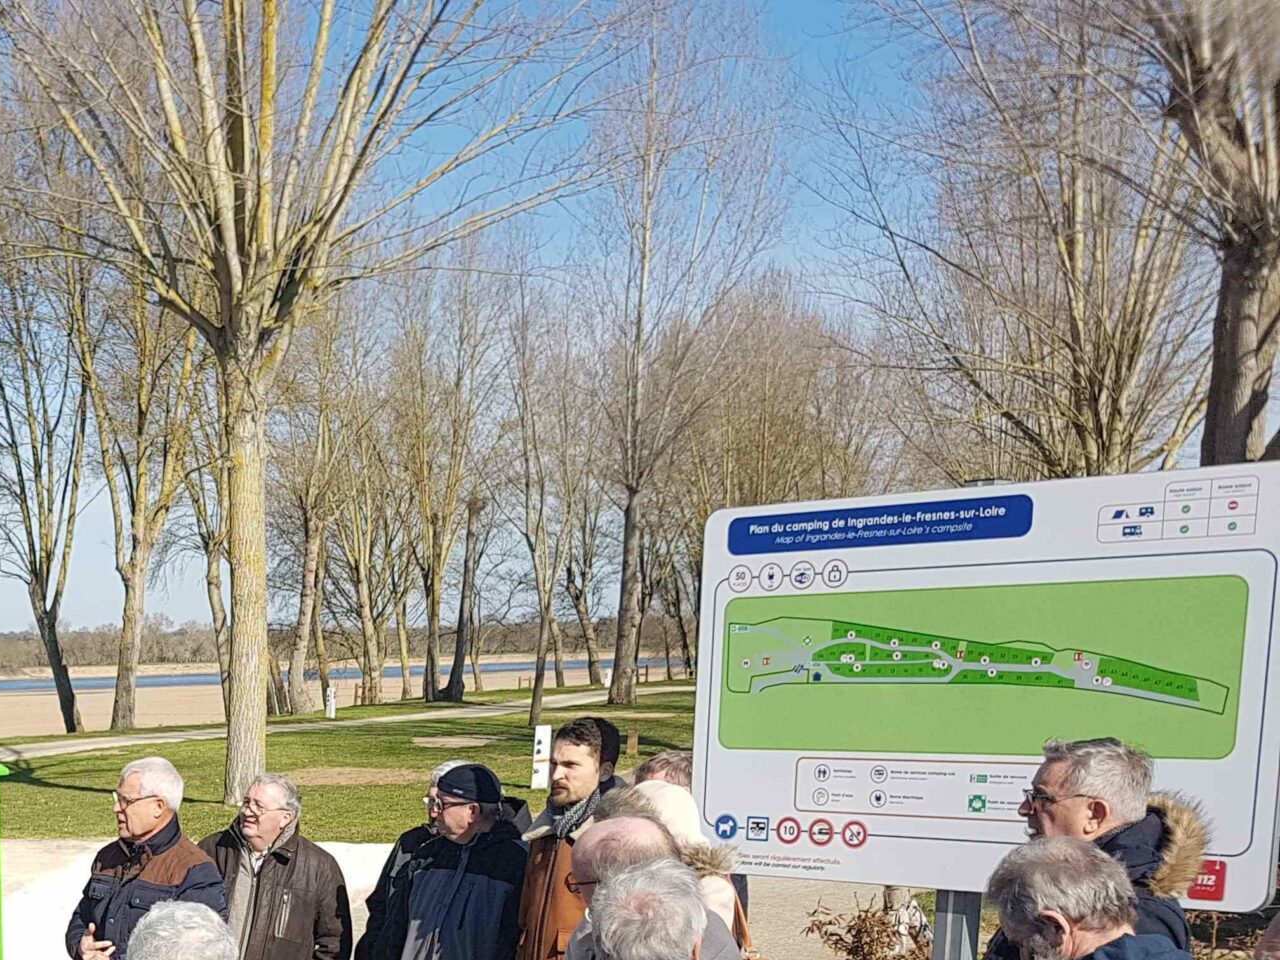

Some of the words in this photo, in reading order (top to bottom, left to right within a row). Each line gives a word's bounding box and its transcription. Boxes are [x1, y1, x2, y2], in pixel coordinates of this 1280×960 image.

[749, 524, 769, 535] Plan
[771, 522, 784, 533] du
[785, 519, 829, 533] camping
[831, 517, 845, 528] de
[847, 506, 1006, 529] Ingrandes-le-Fresnes-sur-Loire
[775, 534, 794, 545] Map
[795, 533, 804, 543] of
[931, 522, 973, 535] campsite
[735, 571, 746, 581] 50
[783, 825, 795, 835] 10
[1197, 874, 1217, 886] 112
